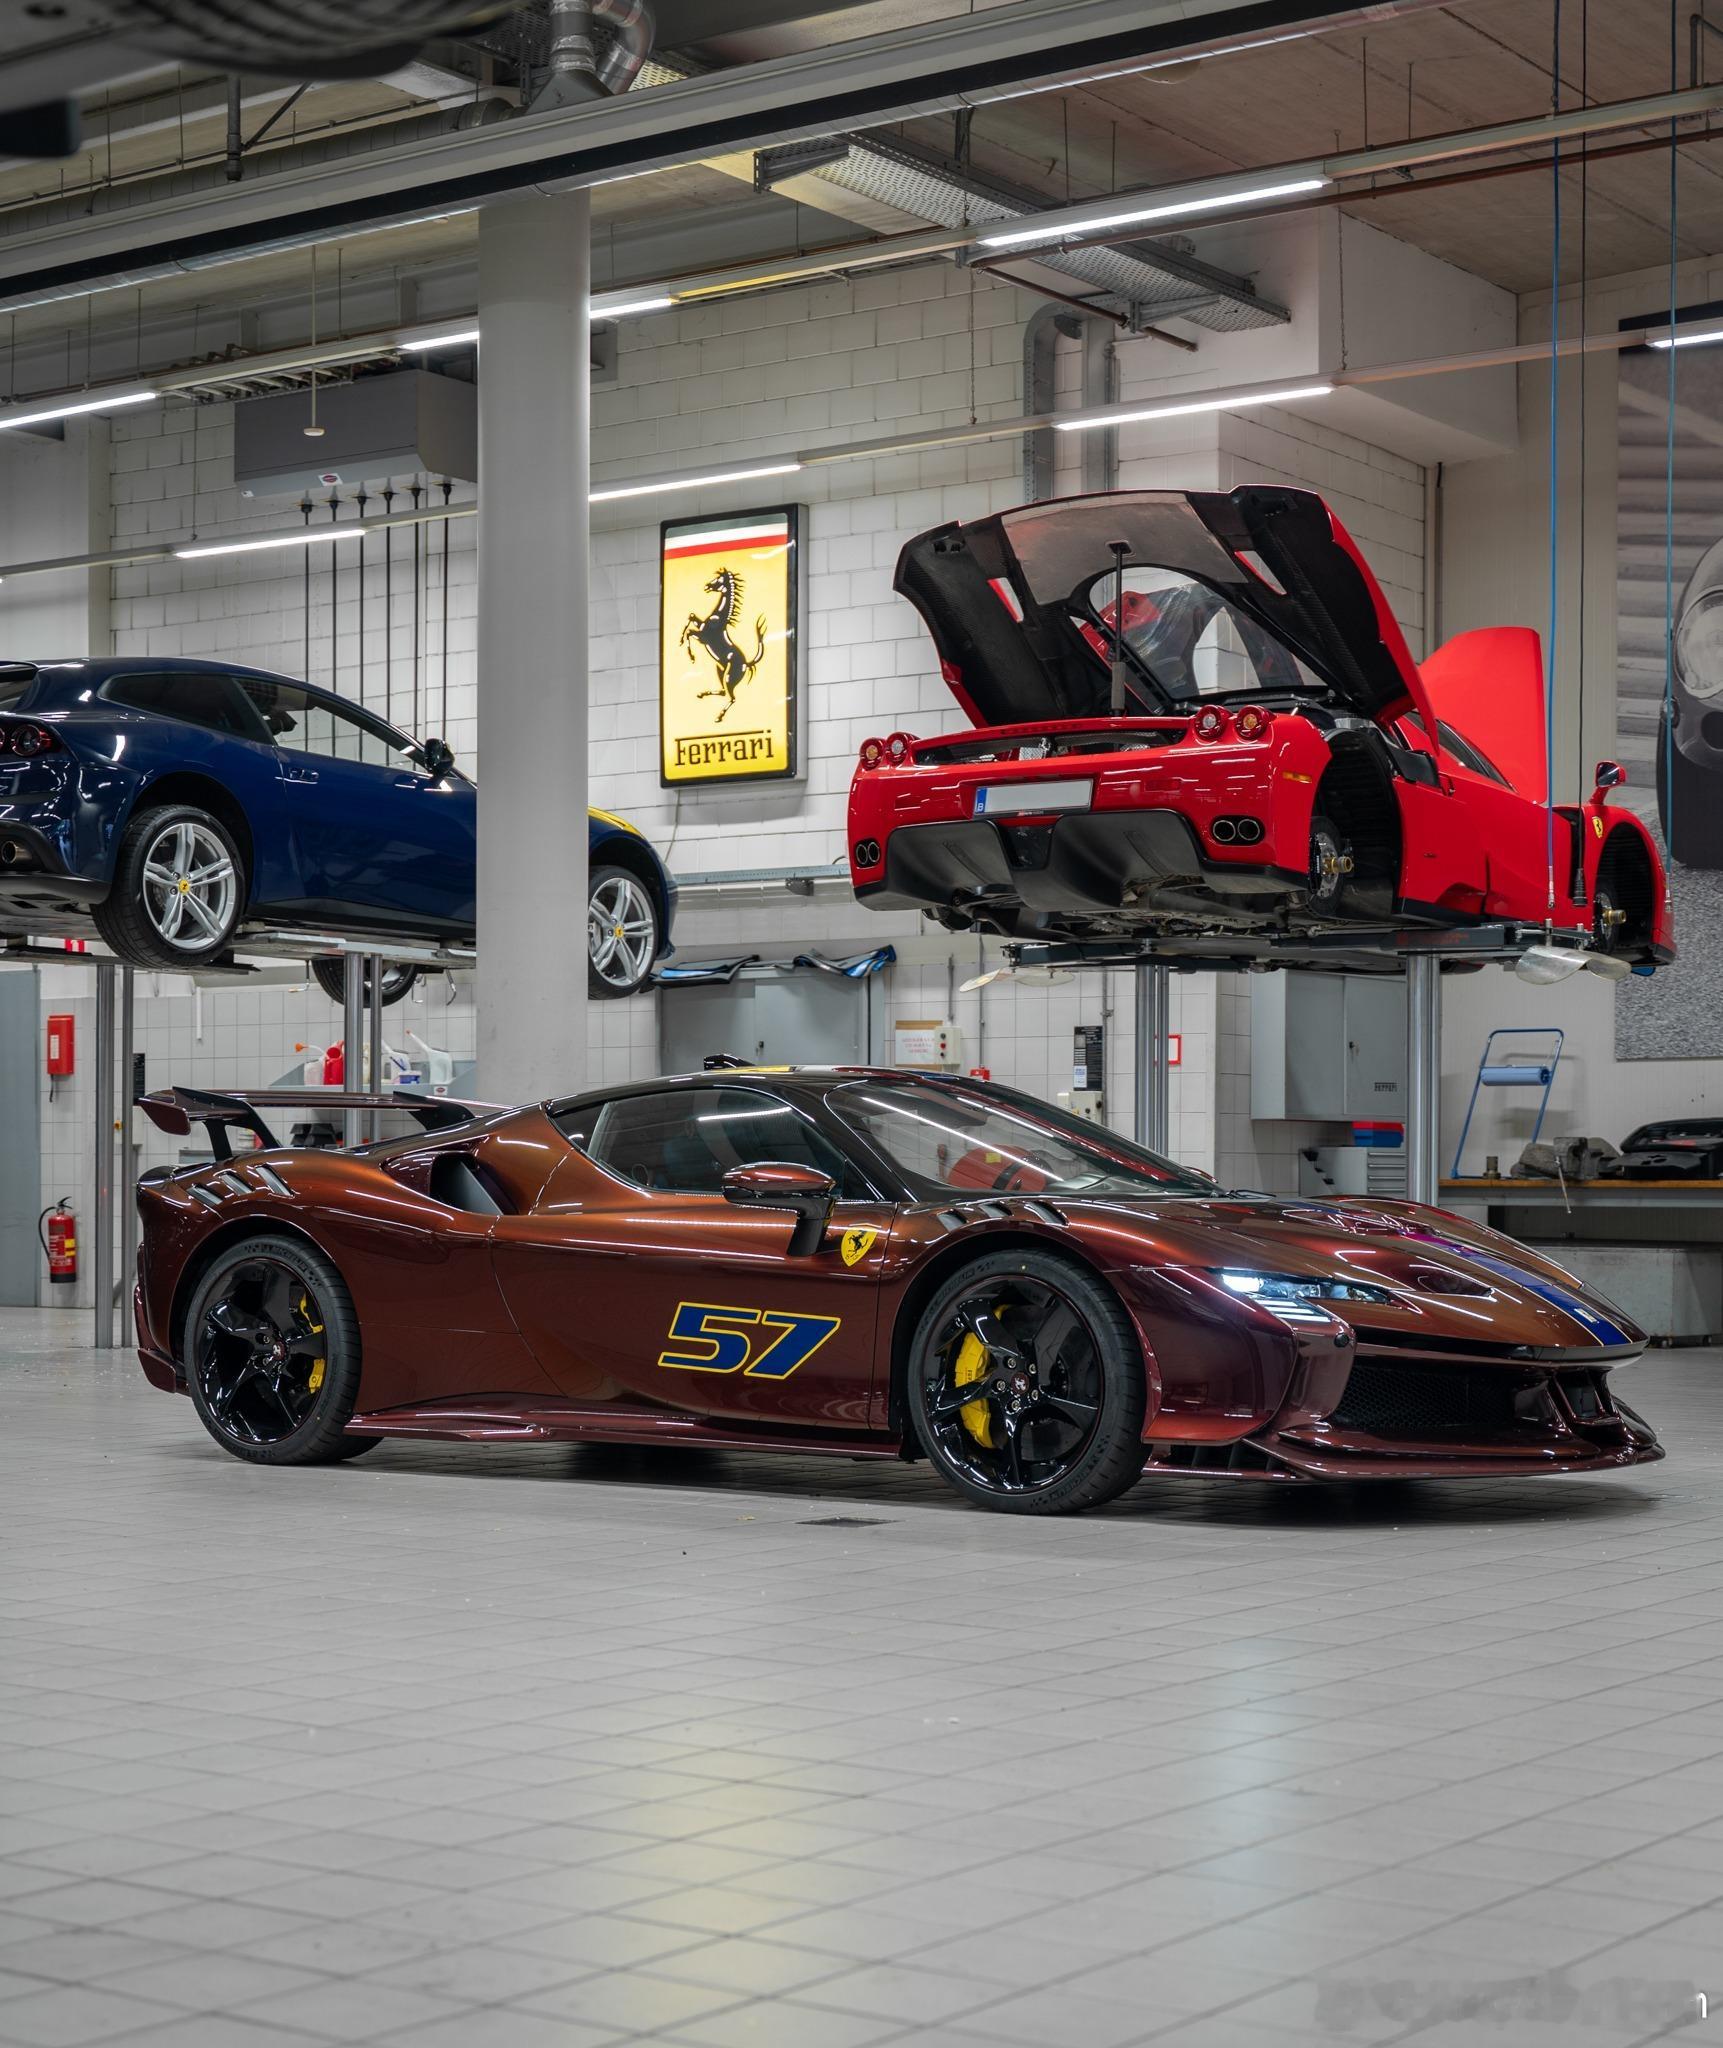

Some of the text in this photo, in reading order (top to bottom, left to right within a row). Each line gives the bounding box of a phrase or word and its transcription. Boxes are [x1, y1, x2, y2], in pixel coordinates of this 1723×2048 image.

[674, 730, 775, 767] Ferrari
[977, 803, 984, 812] B
[657, 1301, 842, 1381] 57
